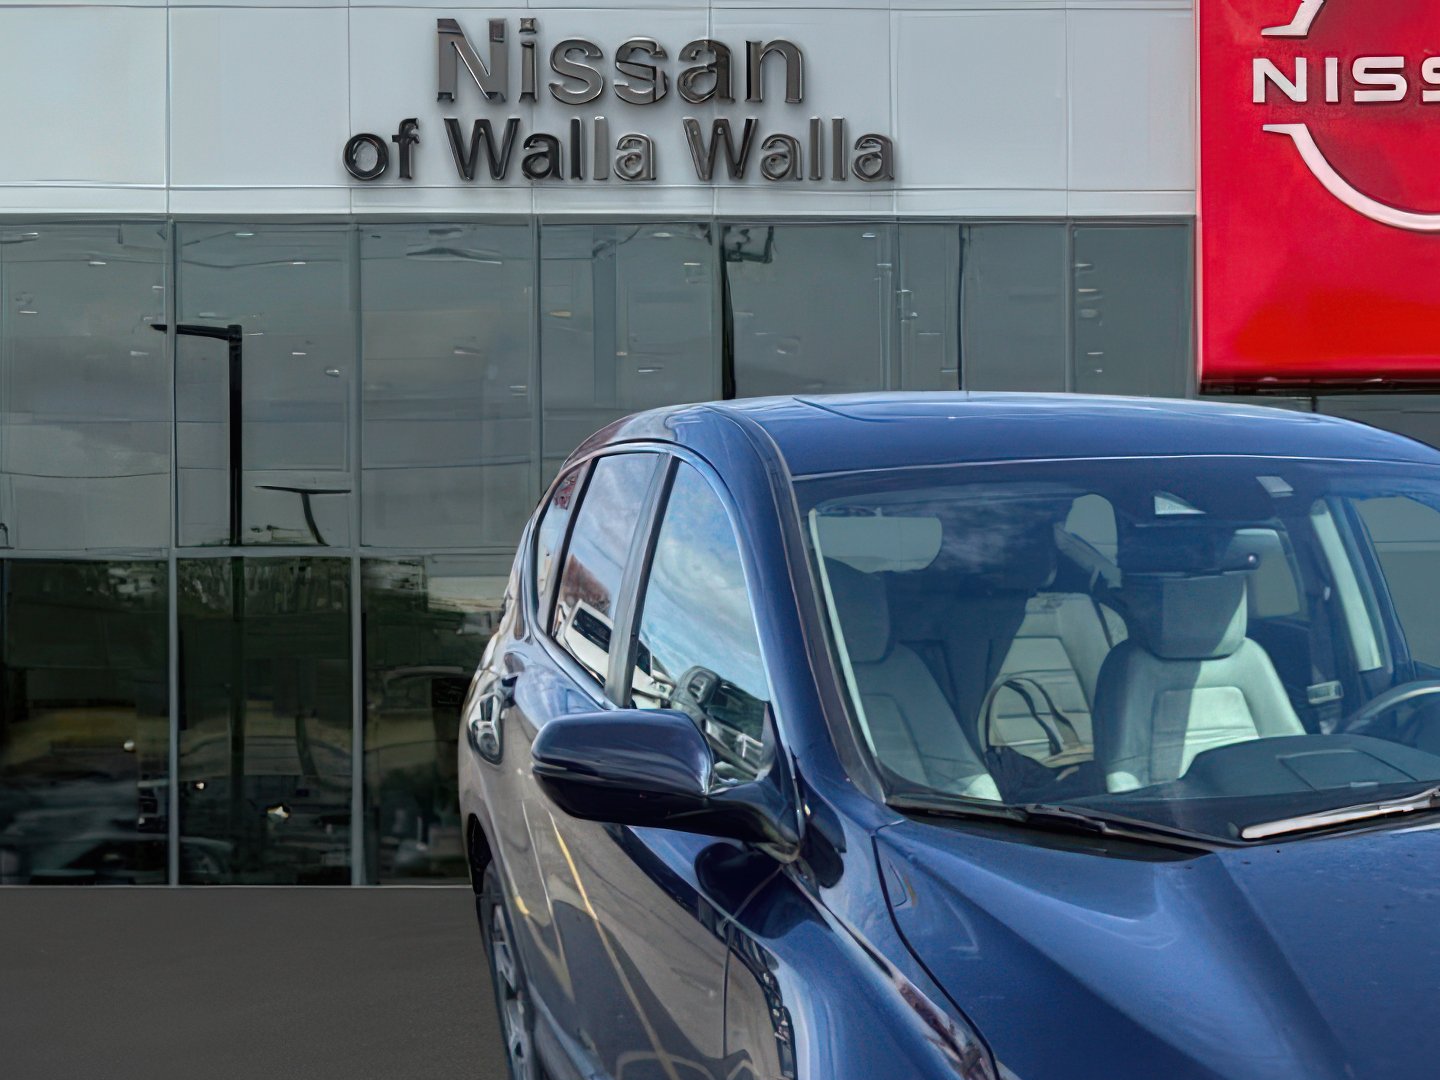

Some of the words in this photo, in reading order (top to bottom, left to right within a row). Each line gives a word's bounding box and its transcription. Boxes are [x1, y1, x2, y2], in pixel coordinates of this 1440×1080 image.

[437, 18, 806, 105] Nissan
[342, 117, 420, 181] of
[444, 116, 656, 182] Walla
[682, 116, 894, 182] Walla
